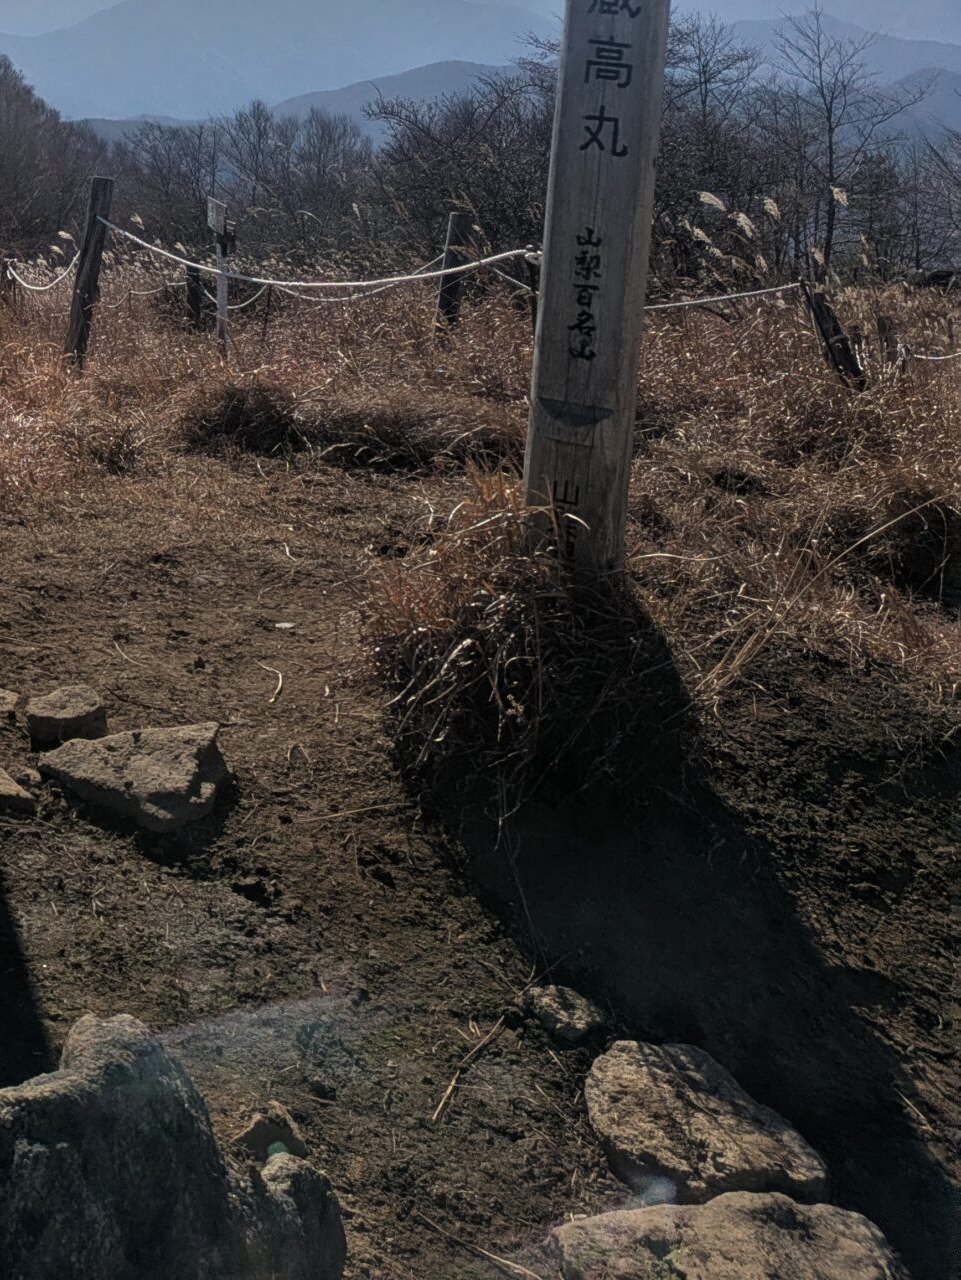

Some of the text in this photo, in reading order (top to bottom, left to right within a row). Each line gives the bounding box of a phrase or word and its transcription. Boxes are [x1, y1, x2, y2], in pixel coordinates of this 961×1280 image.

[567, 227, 603, 362] 山梨百名山
